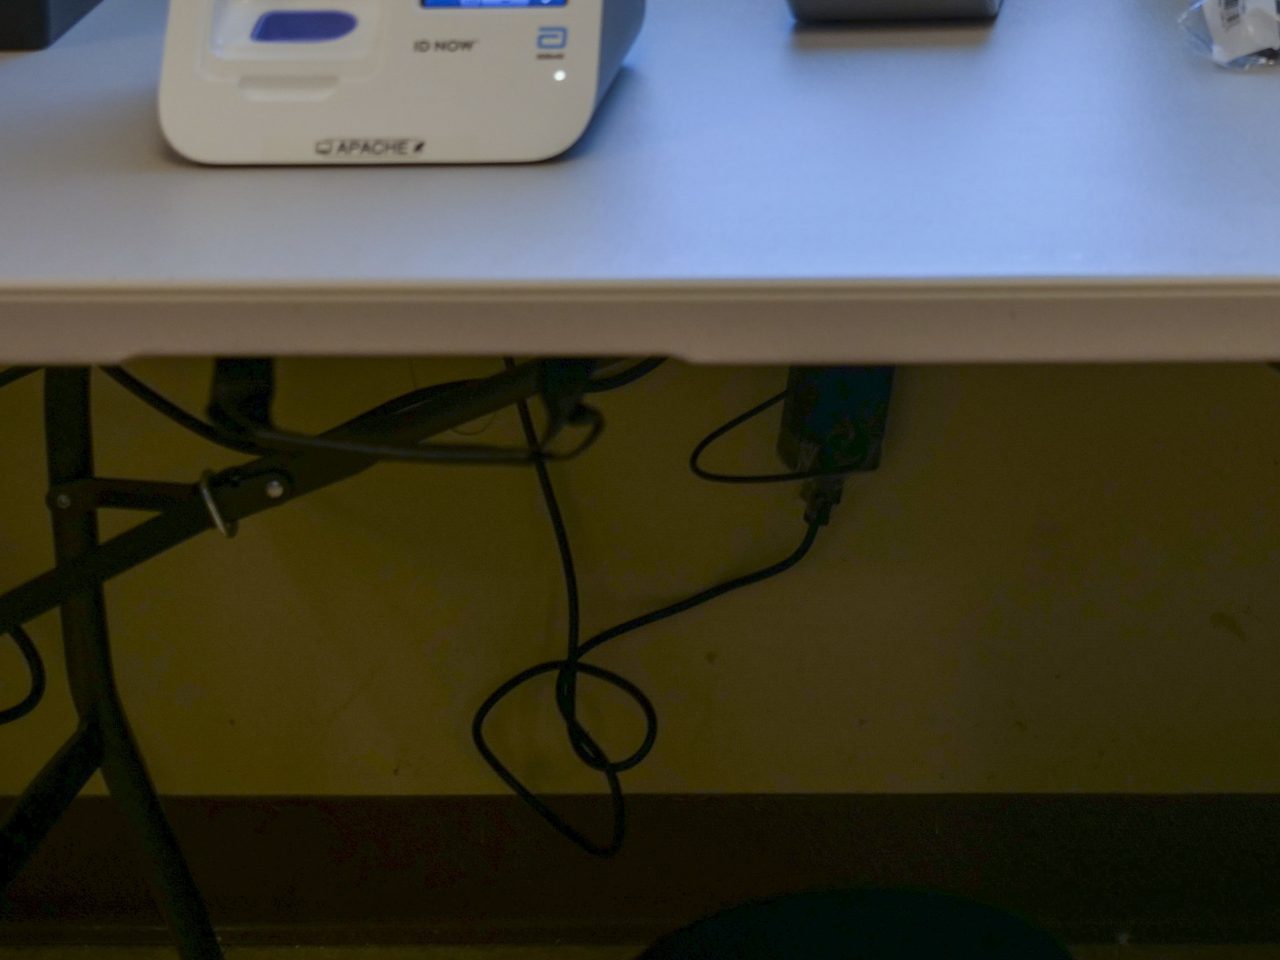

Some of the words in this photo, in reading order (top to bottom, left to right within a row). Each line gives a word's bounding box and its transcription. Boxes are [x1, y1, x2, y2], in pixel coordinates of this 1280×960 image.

[413, 40, 431, 53] ID
[434, 40, 474, 53] NOW
[336, 140, 409, 156] APACHE
